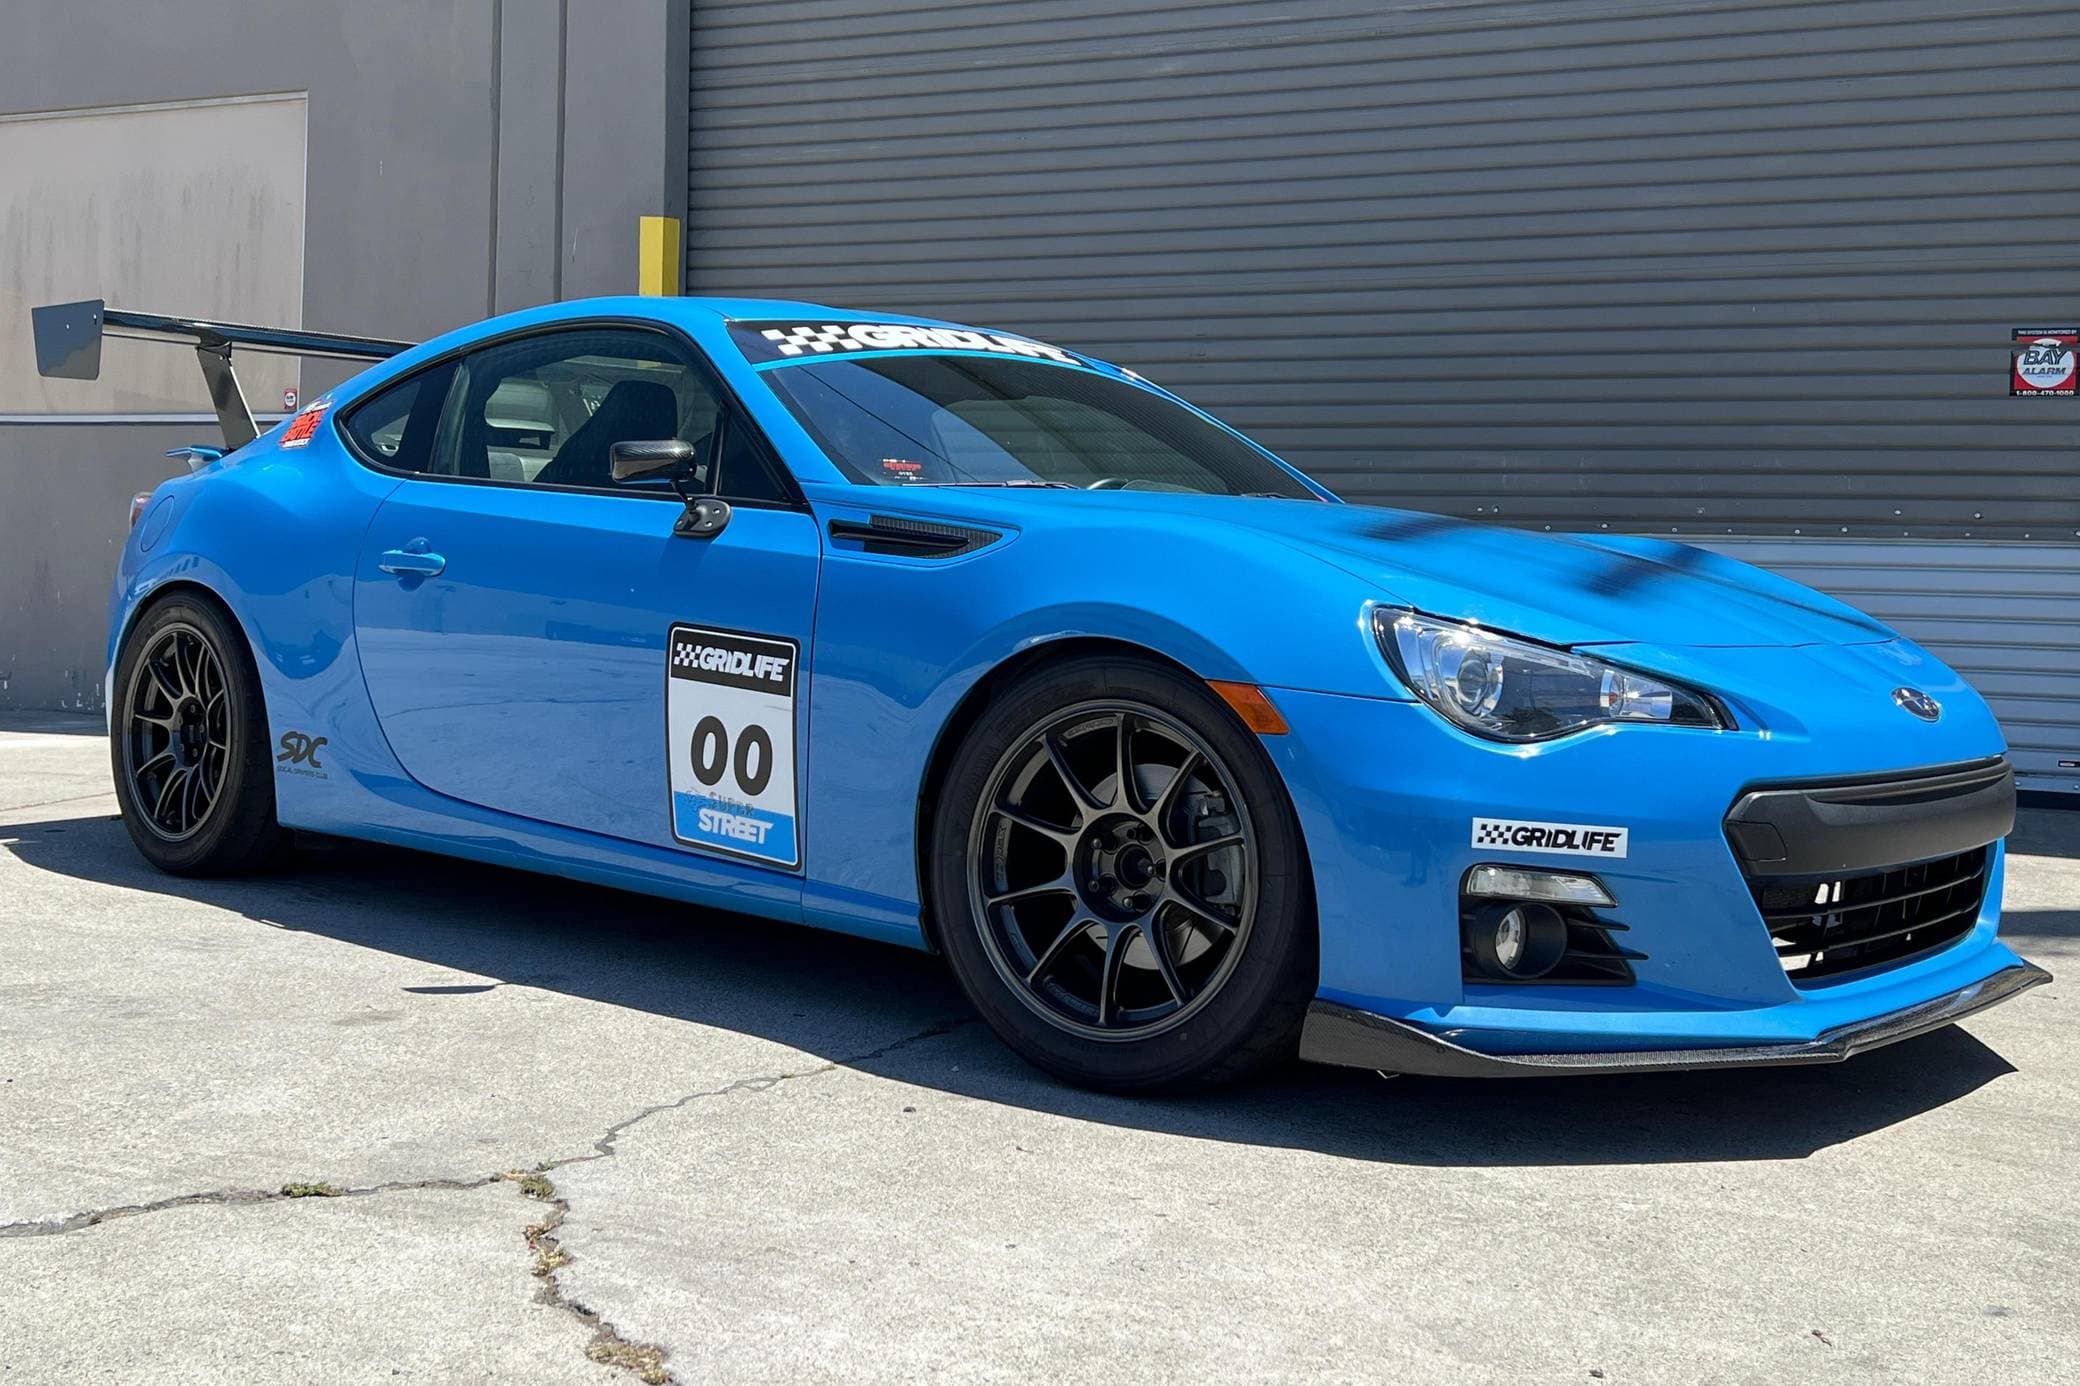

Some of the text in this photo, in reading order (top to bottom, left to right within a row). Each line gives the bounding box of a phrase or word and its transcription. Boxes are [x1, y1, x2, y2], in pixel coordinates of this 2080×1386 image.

[2022, 367, 2066, 375] ALARM
[2023, 349, 2067, 365] BAY
[699, 647, 790, 682] GRIDLIFE
[277, 731, 328, 769] SDC
[690, 715, 773, 796] 00
[698, 808, 774, 844] STREET
[1511, 826, 1622, 852] GRIDLIFE
